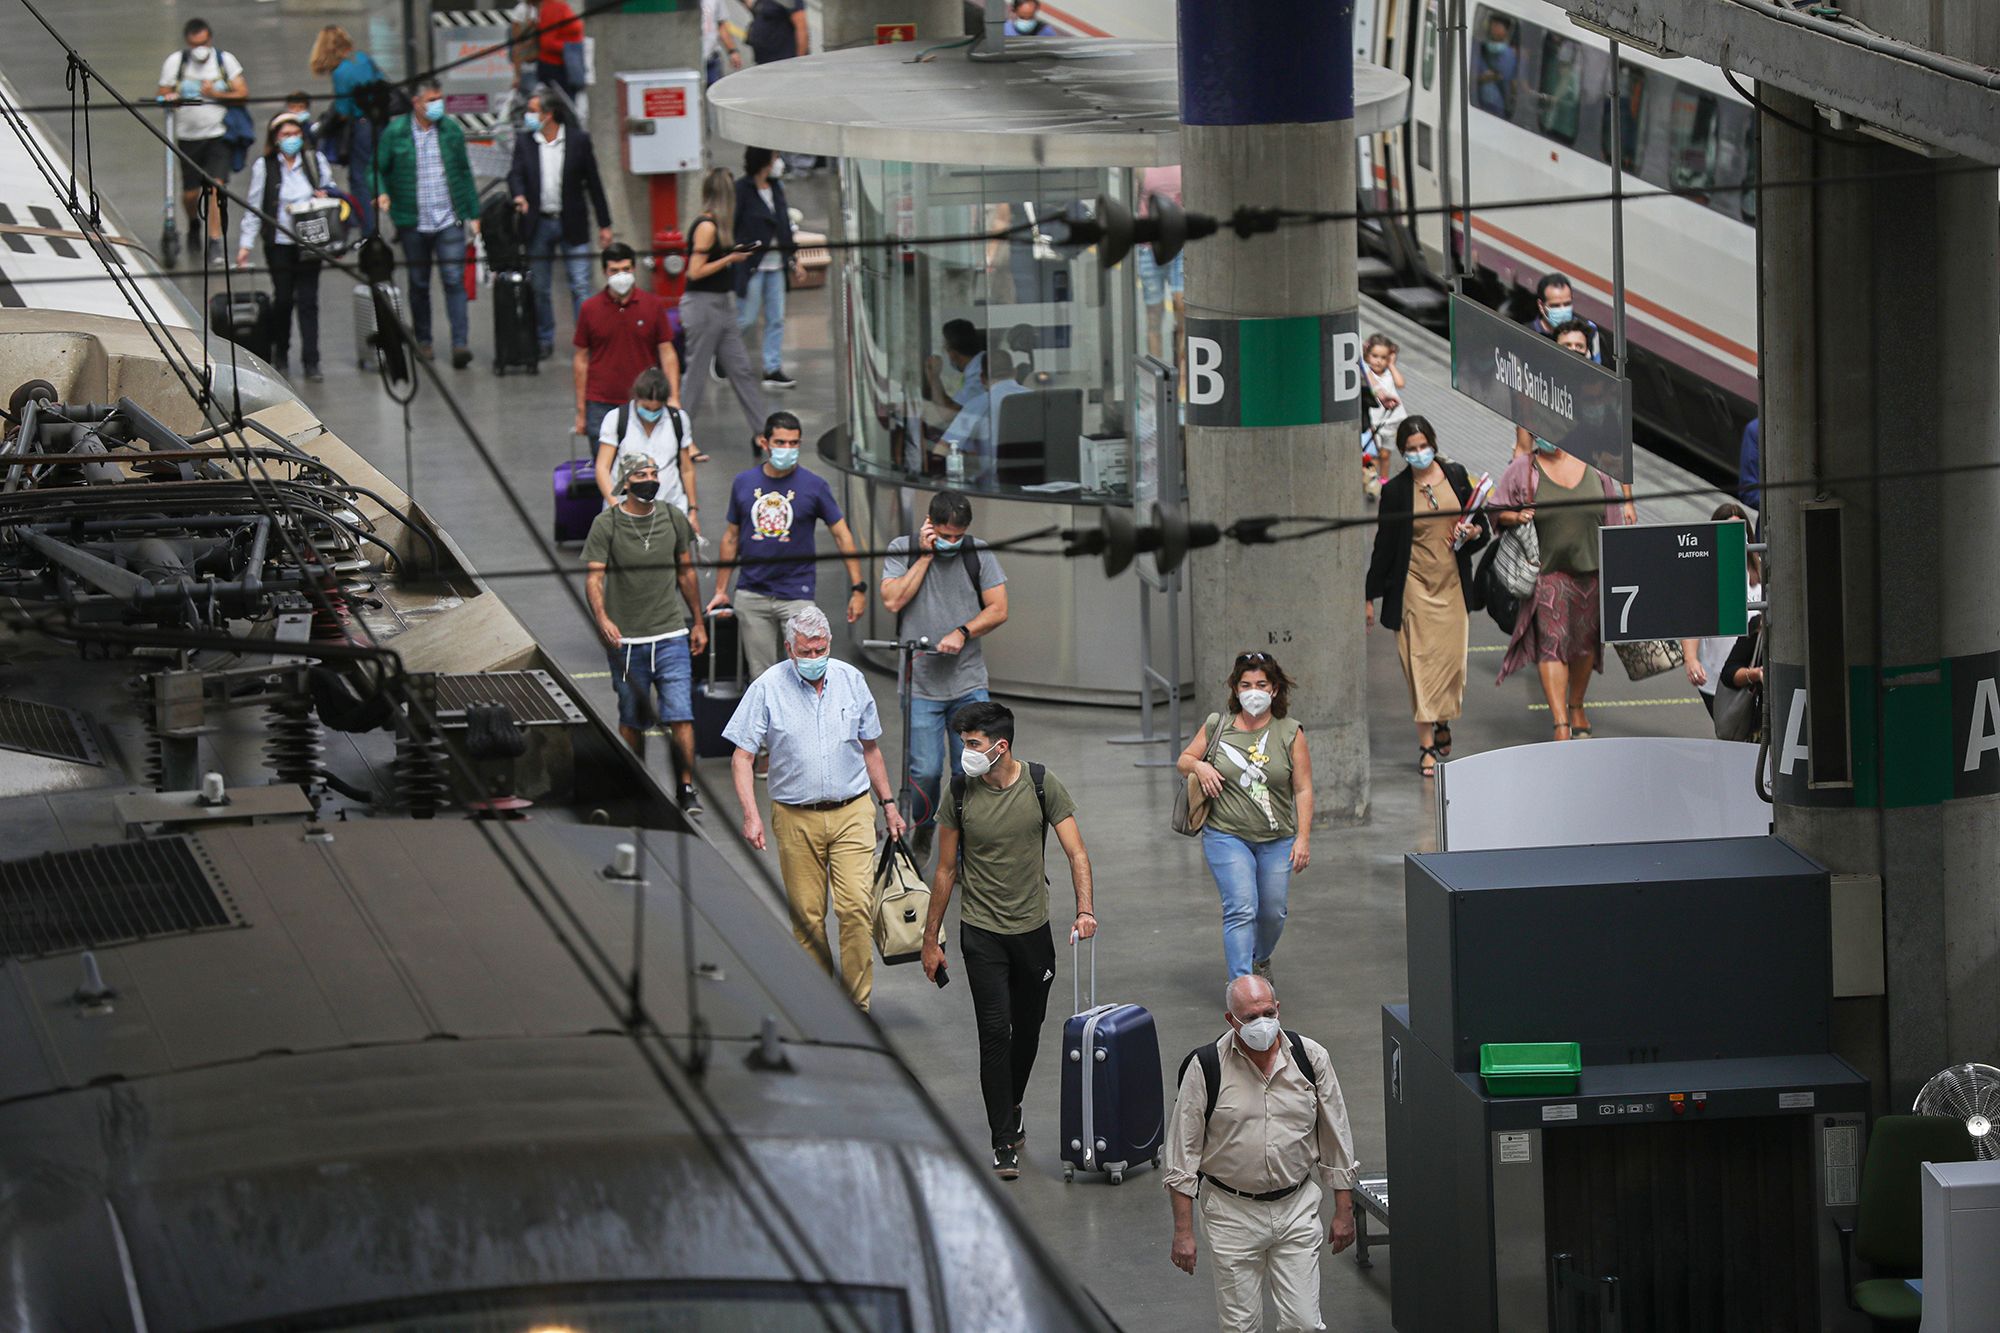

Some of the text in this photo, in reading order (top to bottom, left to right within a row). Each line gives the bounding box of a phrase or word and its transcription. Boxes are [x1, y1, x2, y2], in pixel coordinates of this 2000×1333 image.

[1188, 336, 1225, 405] B
[1333, 332, 1361, 402] B
[1495, 347, 1573, 420] Sevilla Santa Justa
[1677, 533, 1698, 546] Vía
[1678, 550, 1709, 558] PLATFORM
[1611, 585, 1639, 633] 7
[1963, 677, 2000, 772] A
